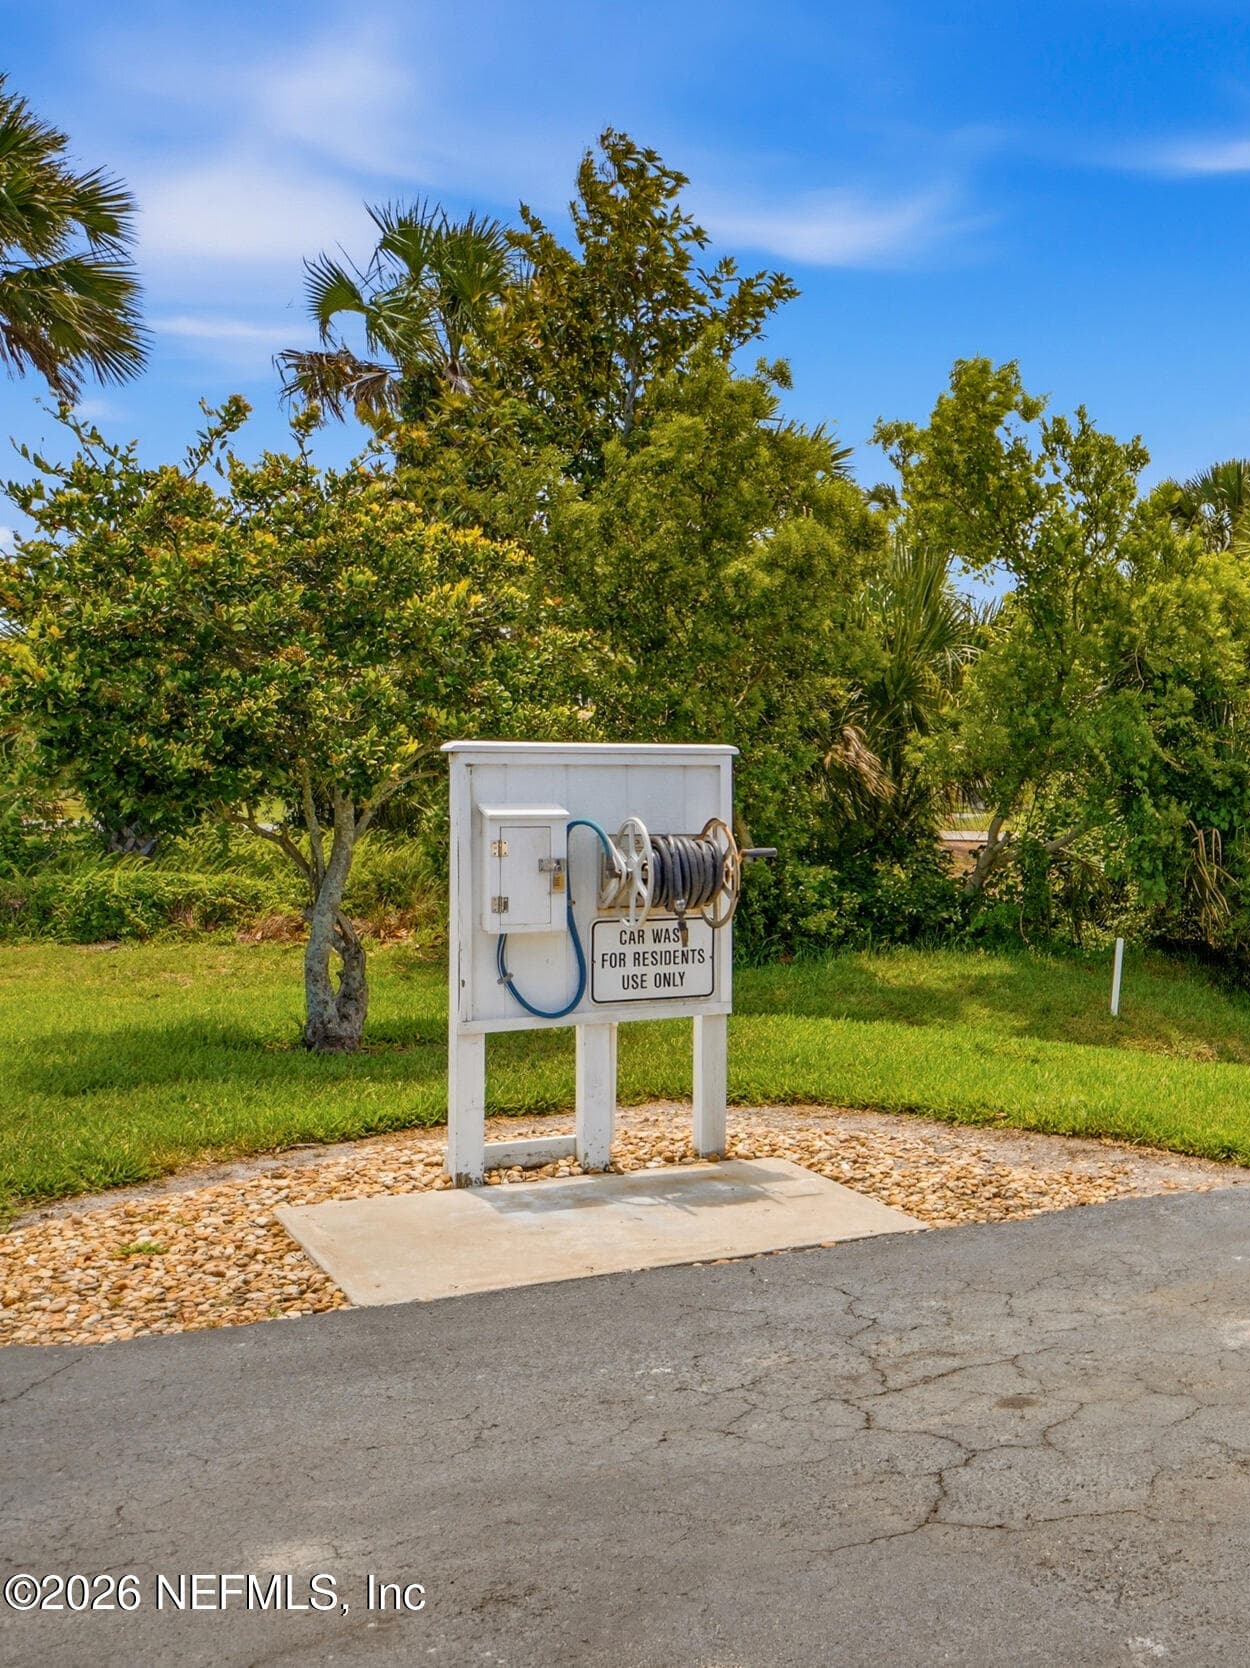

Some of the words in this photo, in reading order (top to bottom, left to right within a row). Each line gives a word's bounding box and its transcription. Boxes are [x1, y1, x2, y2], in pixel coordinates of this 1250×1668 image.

[619, 929, 645, 945] CAR
[652, 928, 687, 944] WAS
[601, 952, 626, 968] FOR
[633, 948, 705, 967] RESIDENTS
[622, 974, 647, 990] USE
[654, 972, 685, 988] ONLY
